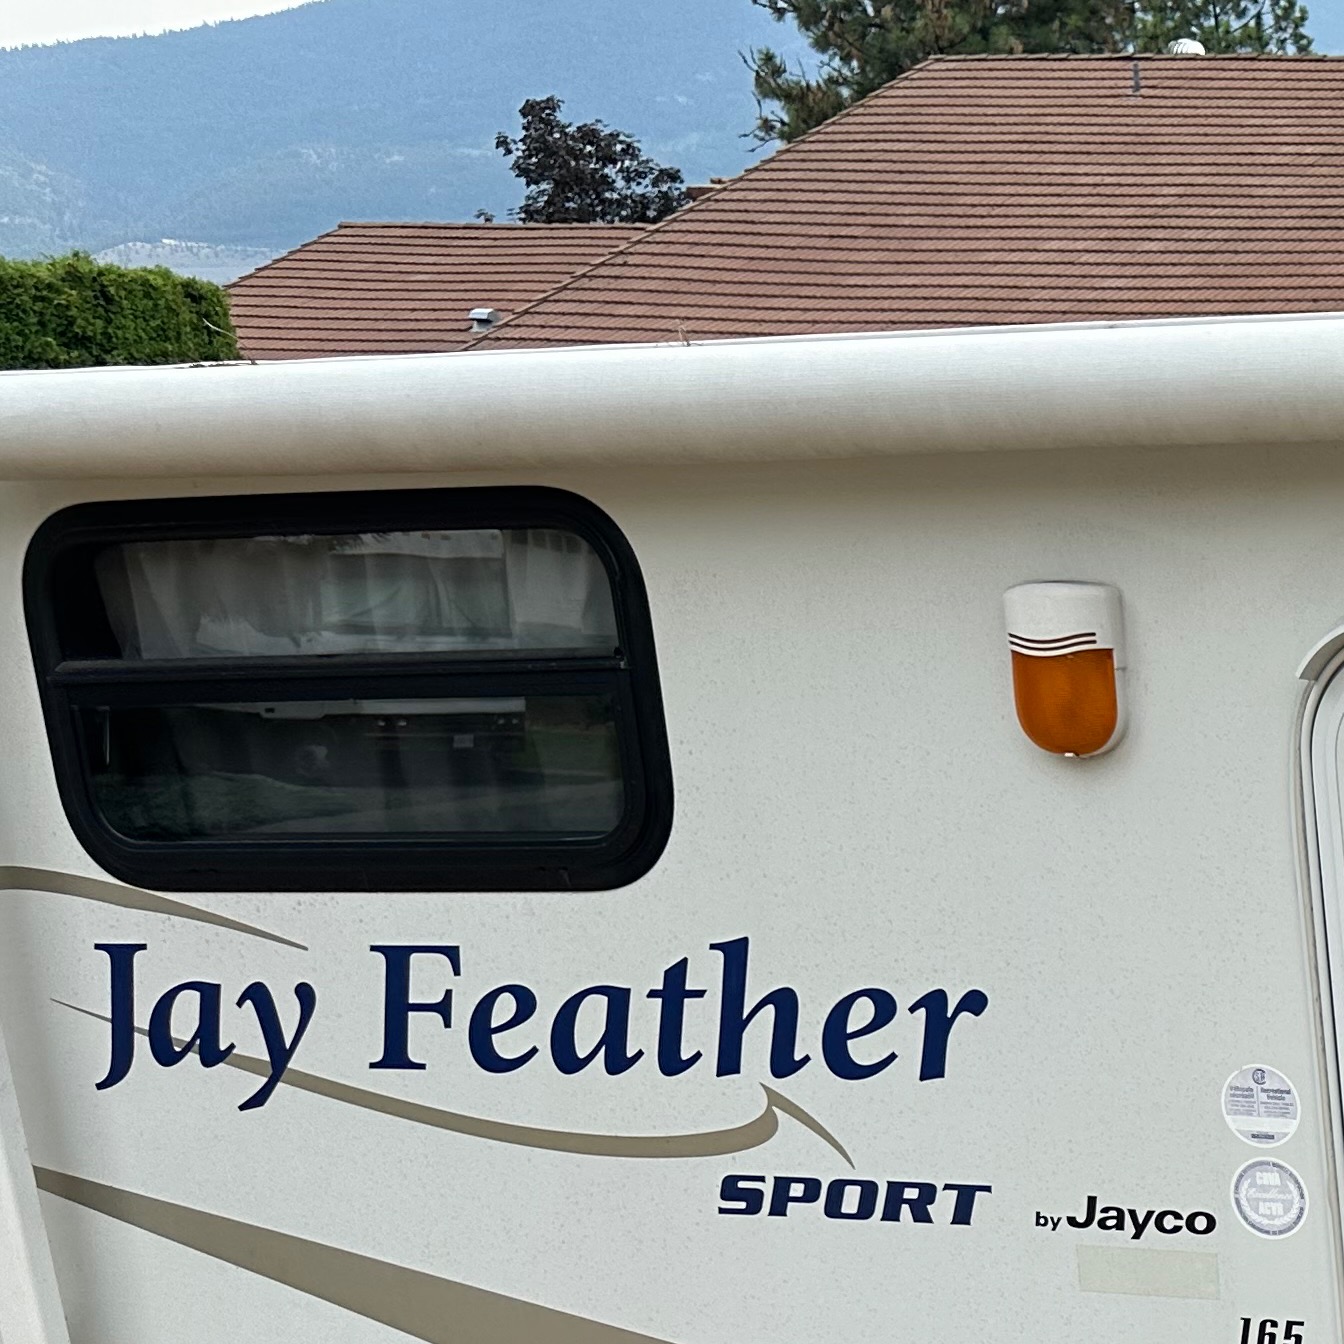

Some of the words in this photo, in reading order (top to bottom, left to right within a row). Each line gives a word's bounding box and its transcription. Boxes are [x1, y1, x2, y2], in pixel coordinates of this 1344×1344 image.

[94, 942, 317, 1111] Jay
[369, 936, 988, 1082] Feather
[718, 1174, 992, 1226] SPORT
[1035, 1211, 1062, 1231] by
[1067, 1195, 1217, 1240] Jayco
